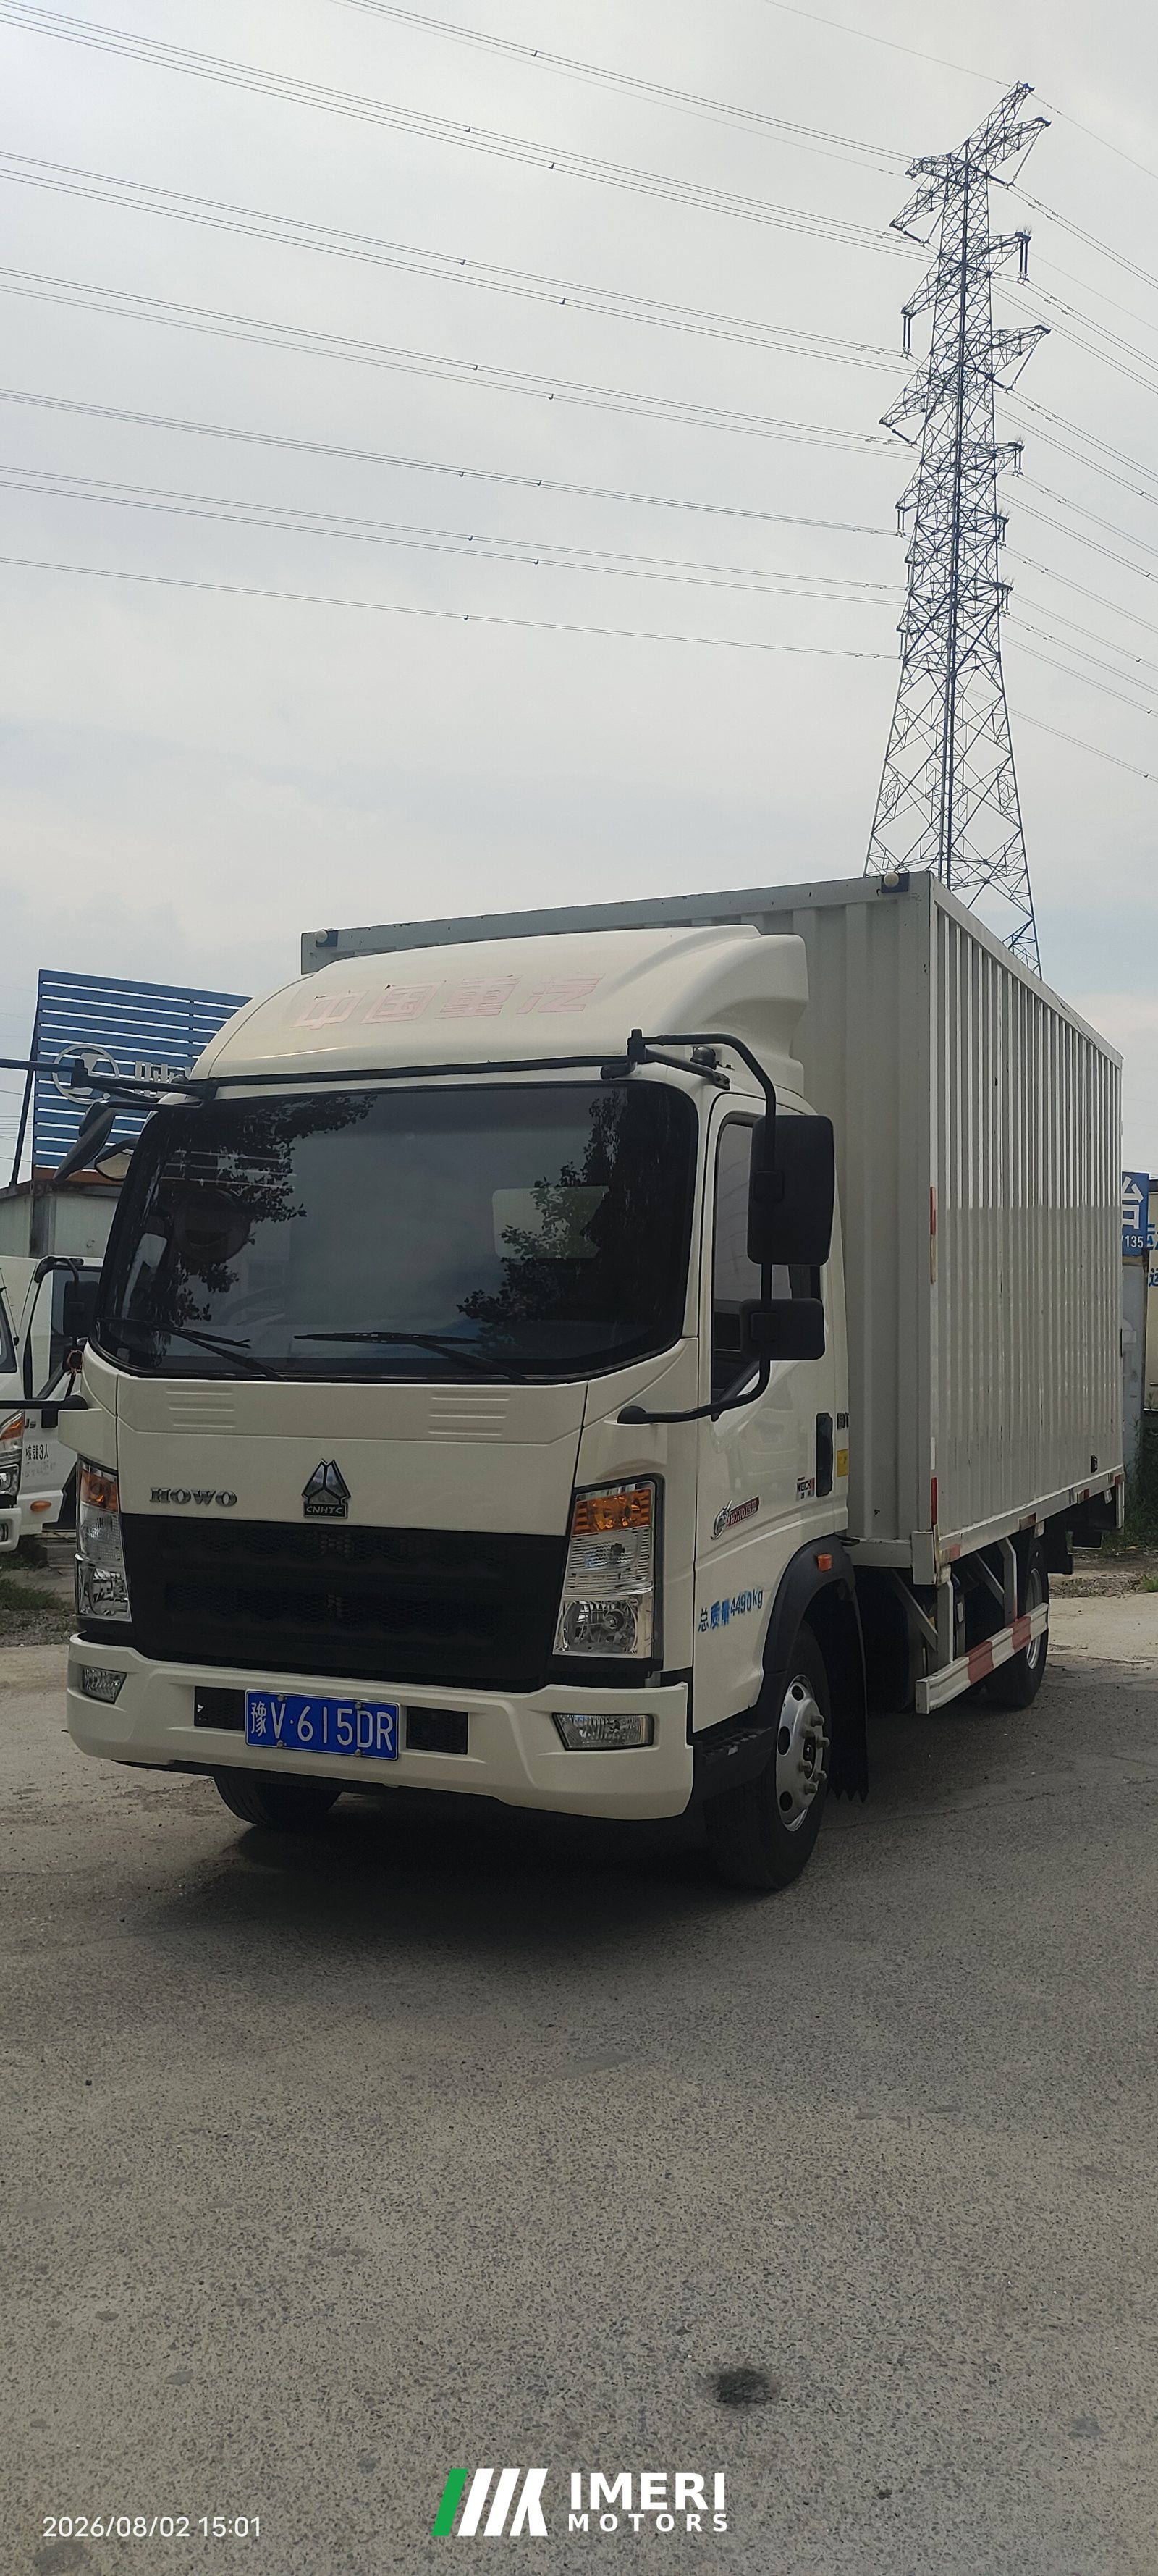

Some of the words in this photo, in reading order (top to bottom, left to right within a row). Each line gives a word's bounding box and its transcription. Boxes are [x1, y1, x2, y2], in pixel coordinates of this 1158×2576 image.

[291, 973, 607, 1030] 中国重汽
[1122, 1235, 1144, 1248] 135
[149, 1487, 237, 1507] HOWO
[305, 1505, 343, 1515] CNHTC
